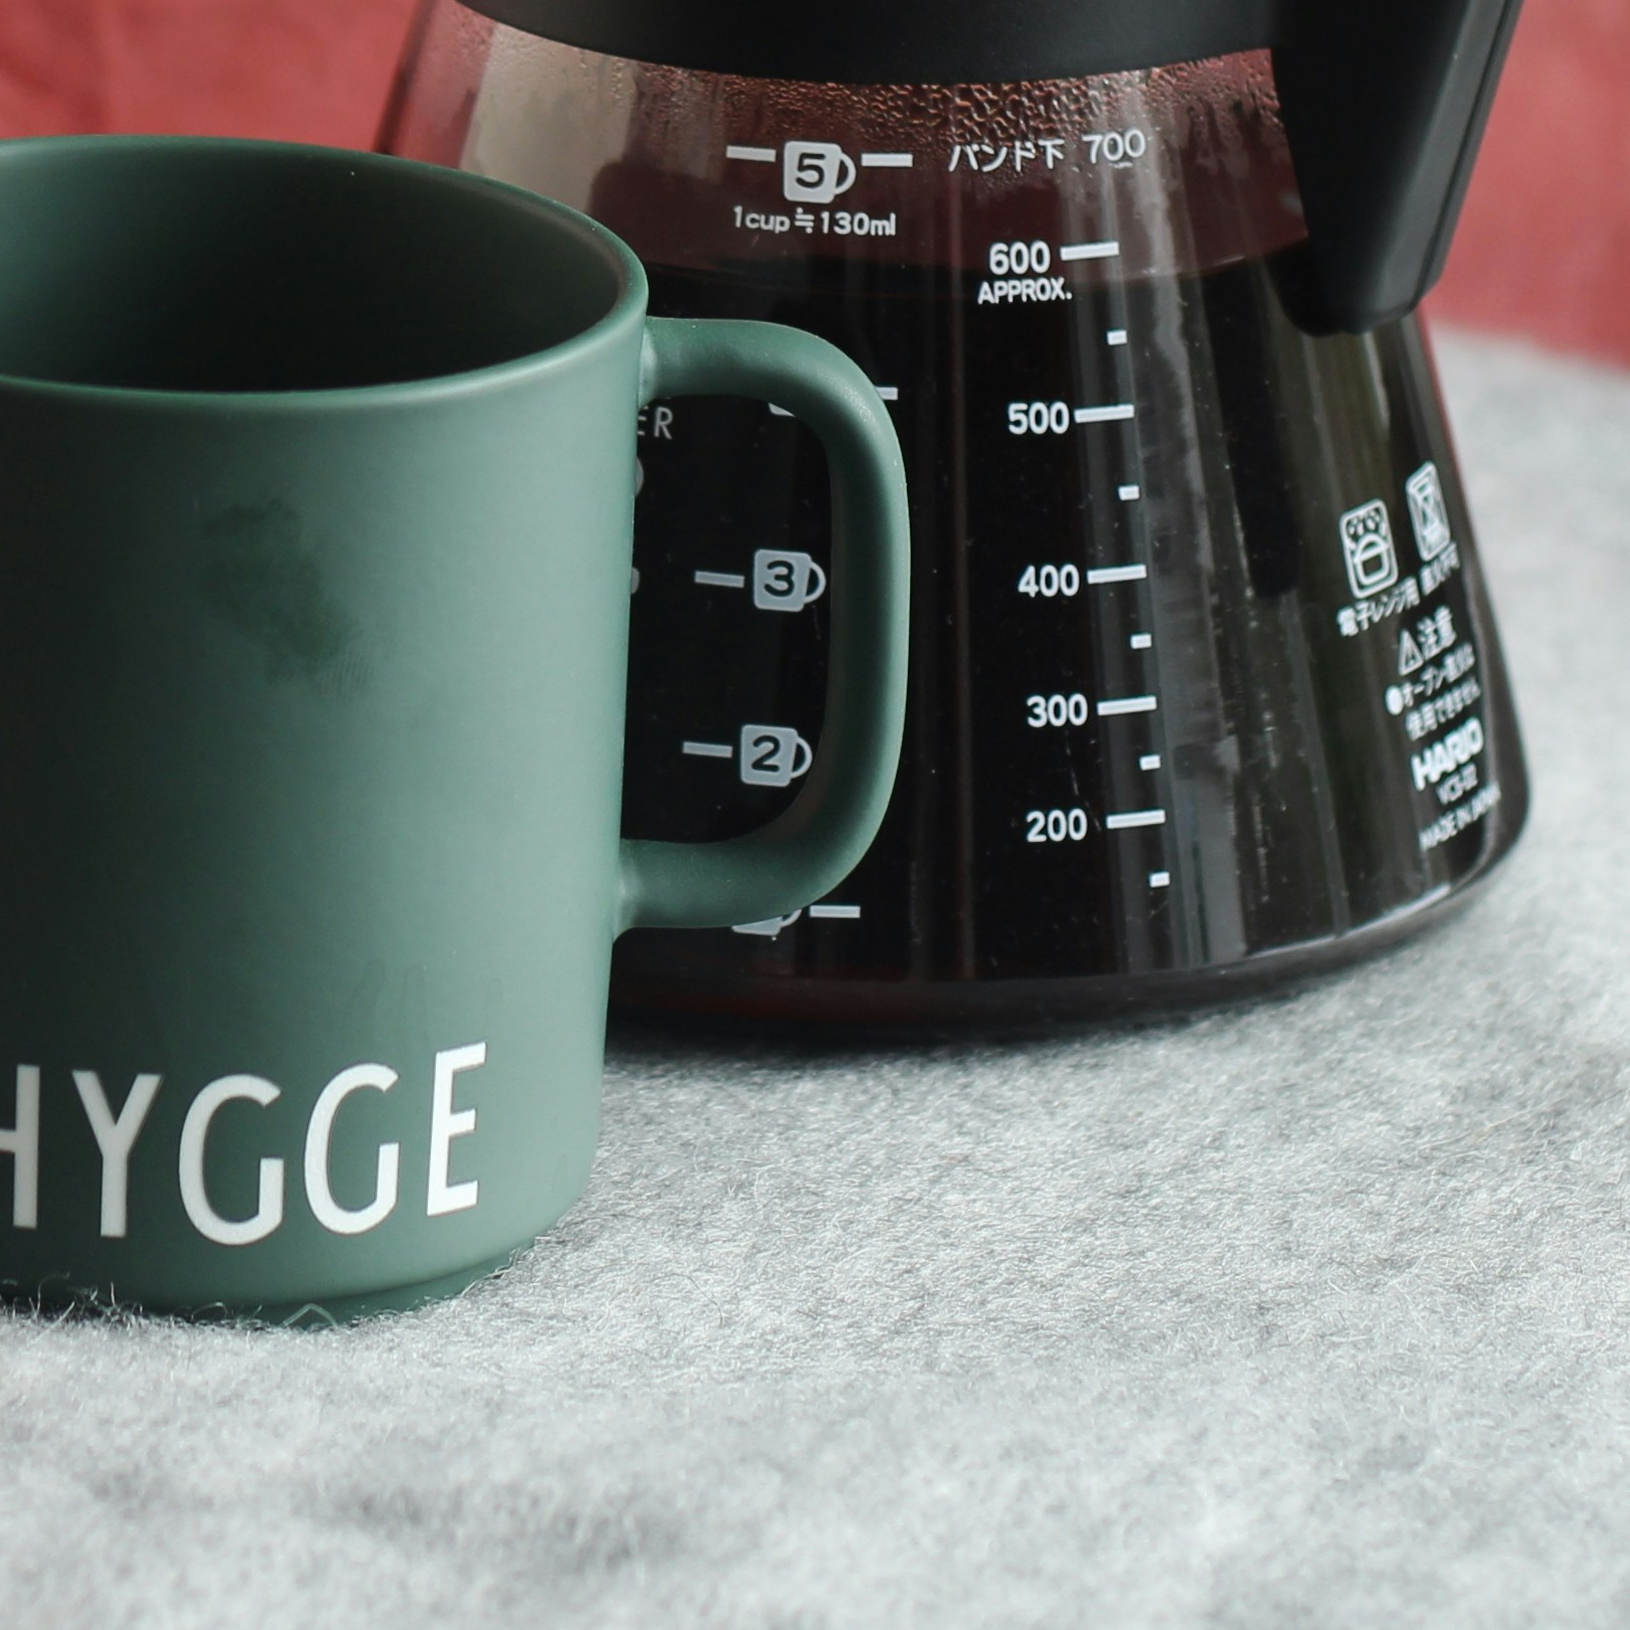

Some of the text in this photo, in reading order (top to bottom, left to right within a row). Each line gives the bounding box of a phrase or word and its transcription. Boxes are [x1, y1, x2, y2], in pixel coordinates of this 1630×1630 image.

[1081, 128, 1147, 164] 700
[795, 152, 826, 189] 5
[989, 239, 1051, 275] 600
[977, 276, 1073, 305] APPROX.
[1007, 401, 1071, 436] 500
[762, 559, 797, 599] 3
[1017, 563, 1081, 598] 400
[1026, 692, 1089, 728] 300
[751, 734, 782, 775] 2
[1410, 717, 1484, 792] HARIO
[1025, 808, 1089, 844] 200
